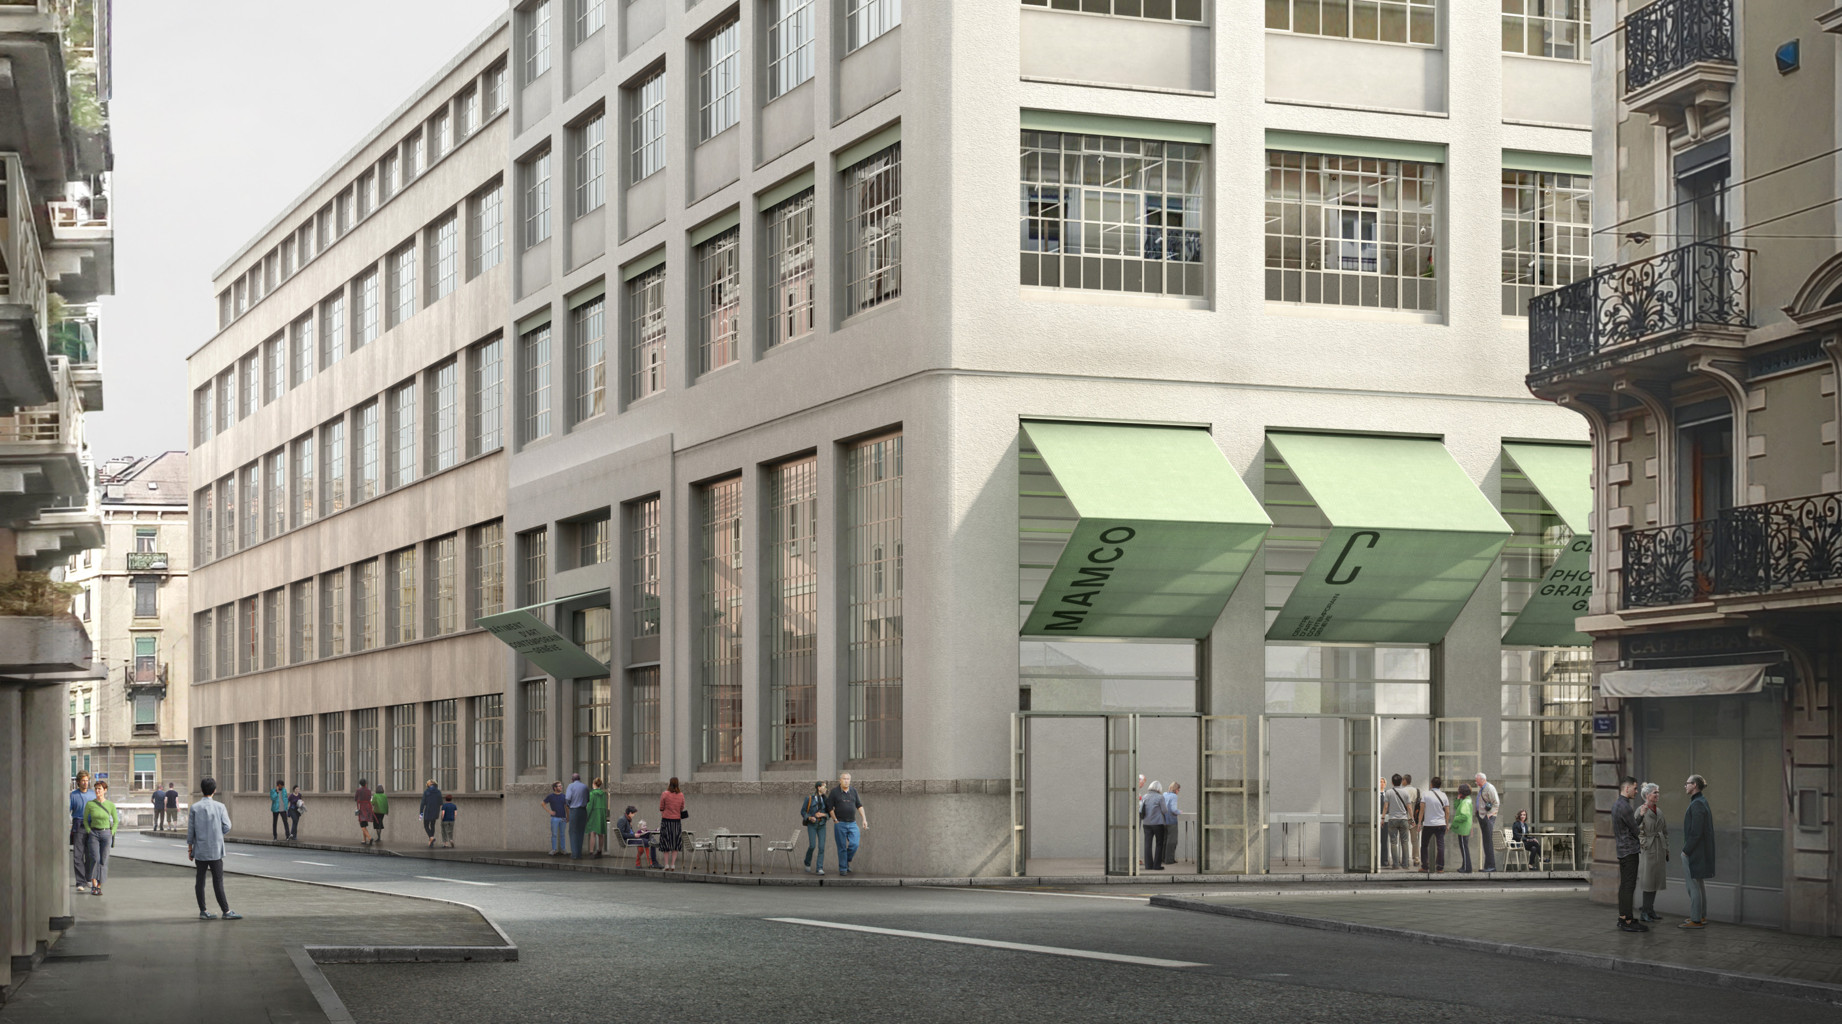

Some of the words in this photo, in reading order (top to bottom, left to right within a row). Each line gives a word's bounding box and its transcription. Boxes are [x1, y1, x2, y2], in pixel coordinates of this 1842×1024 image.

[1044, 526, 1136, 631] MAMCO
[1324, 530, 1381, 586] C
[1572, 599, 1590, 612] G
